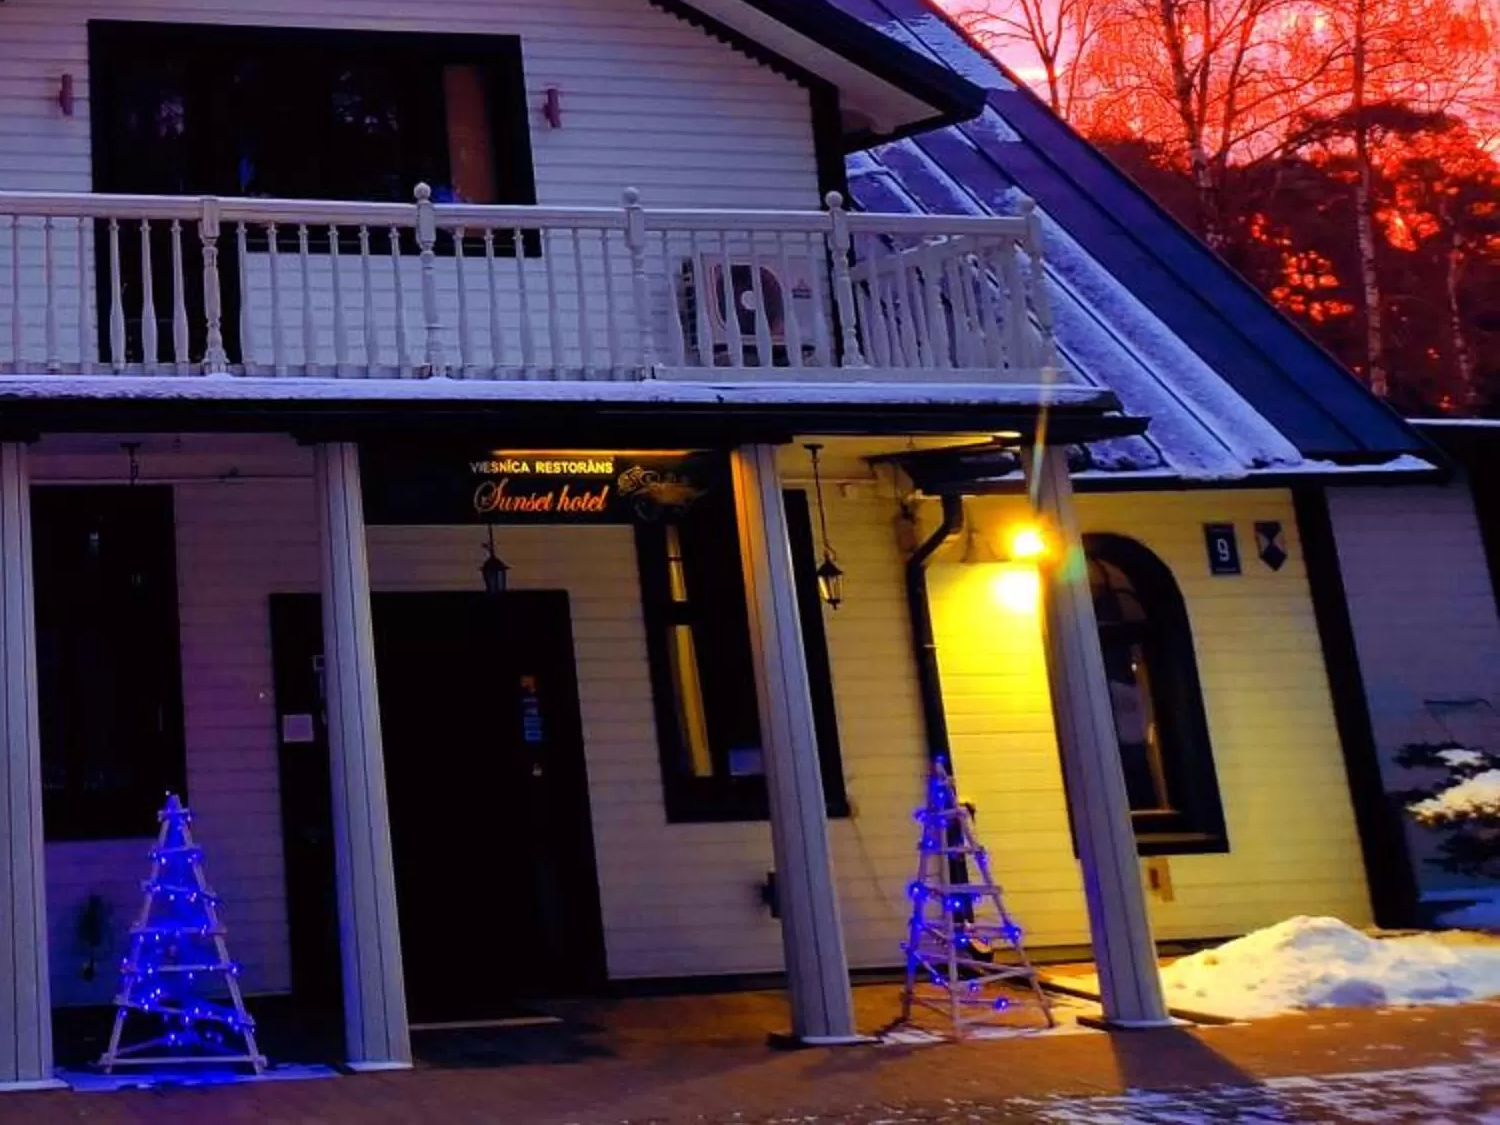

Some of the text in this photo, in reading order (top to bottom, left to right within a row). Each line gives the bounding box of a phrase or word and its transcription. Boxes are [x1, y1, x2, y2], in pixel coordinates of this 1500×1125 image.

[470, 457, 613, 474] VIESNĪCA RESTORĀNS
[473, 477, 611, 513] Sunset hotel
[1217, 538, 1231, 562] 9
